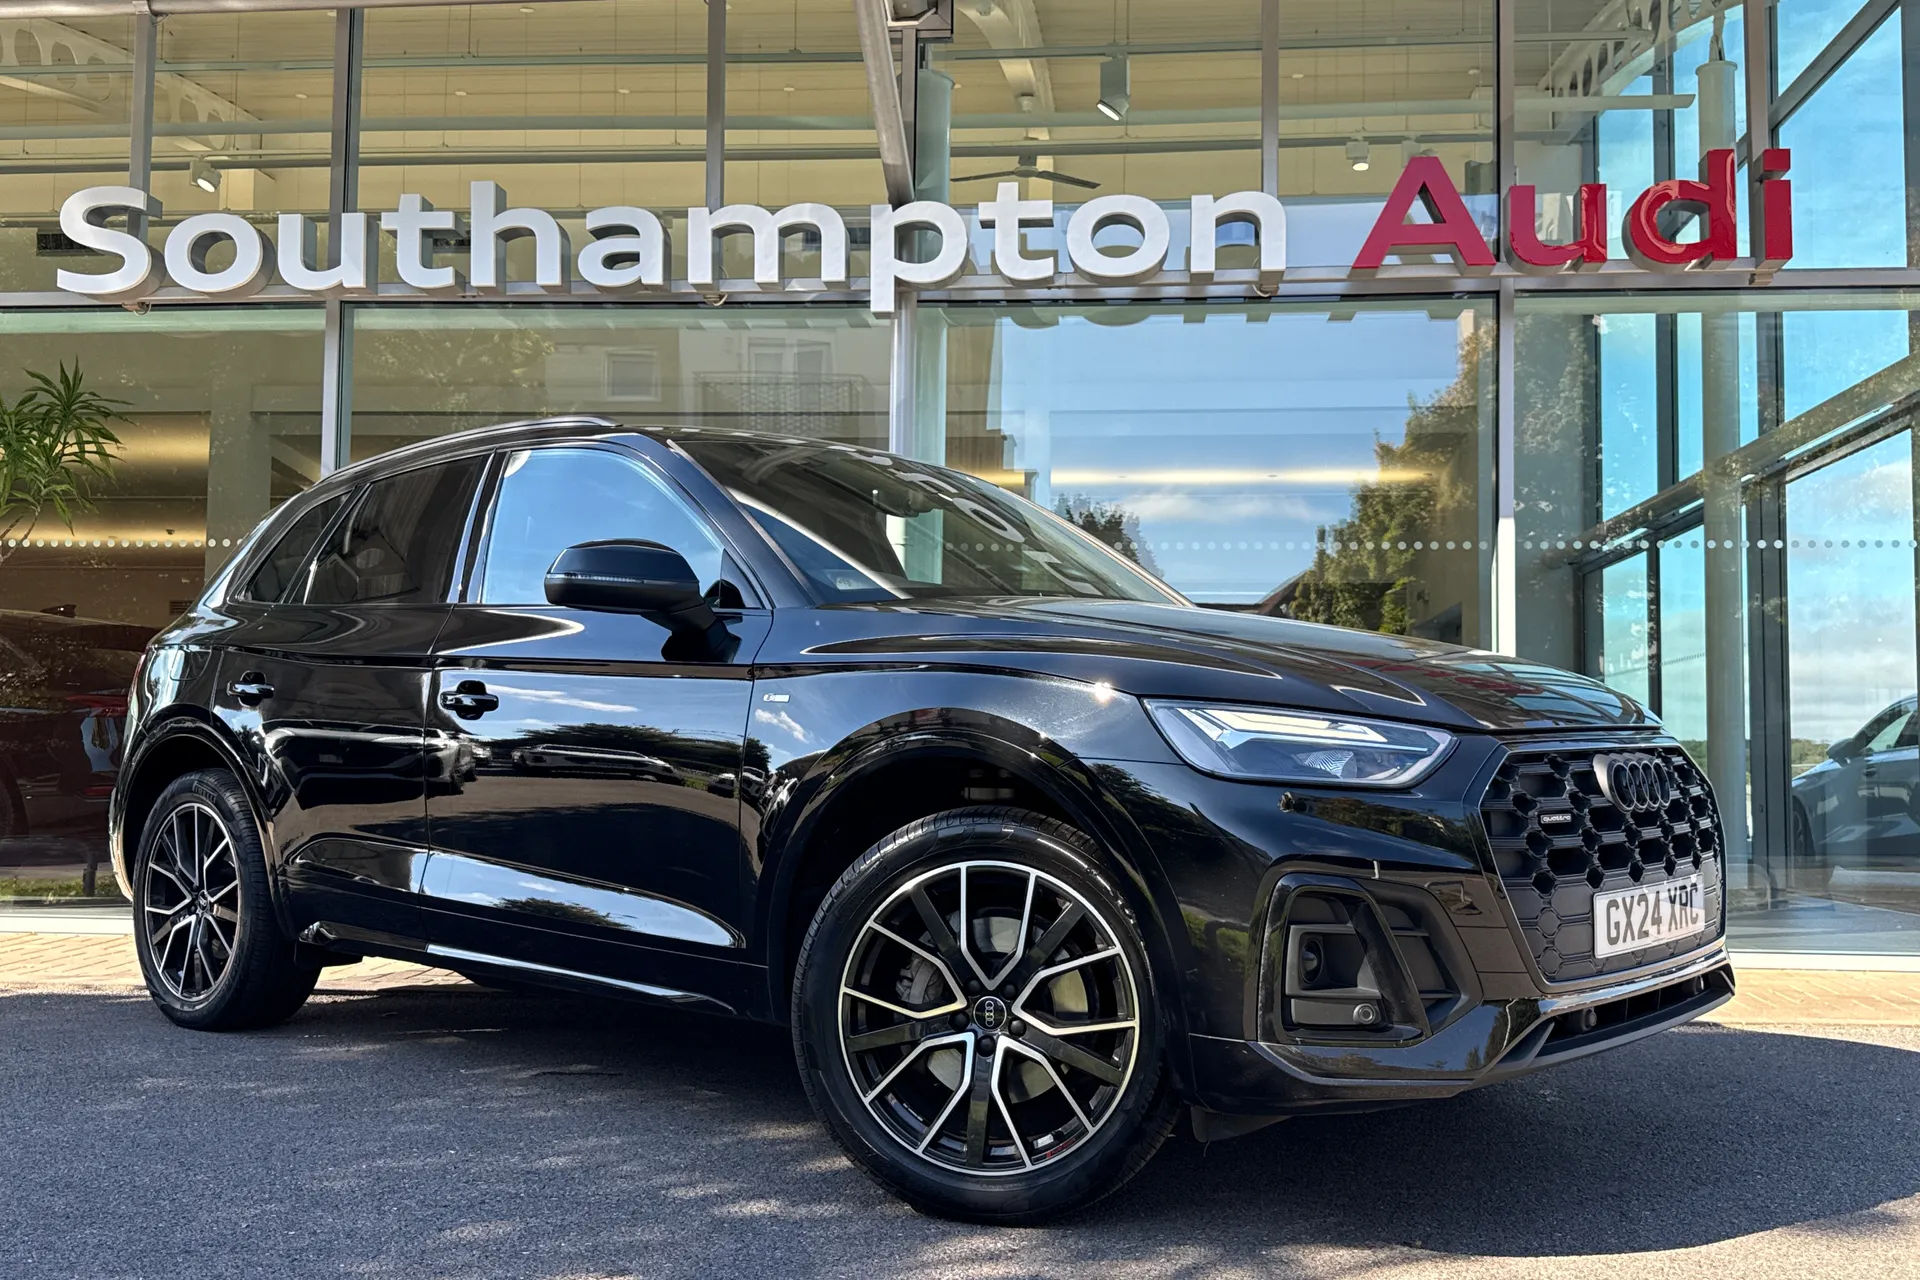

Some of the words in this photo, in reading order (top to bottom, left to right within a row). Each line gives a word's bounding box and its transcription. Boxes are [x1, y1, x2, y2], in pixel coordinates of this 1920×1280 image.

[57, 181, 1287, 314] Southampton
[1353, 148, 1793, 269] Audi
[1542, 815, 1571, 823] quattro
[1606, 891, 1662, 946] GX24
[1667, 883, 1698, 932] XRC
